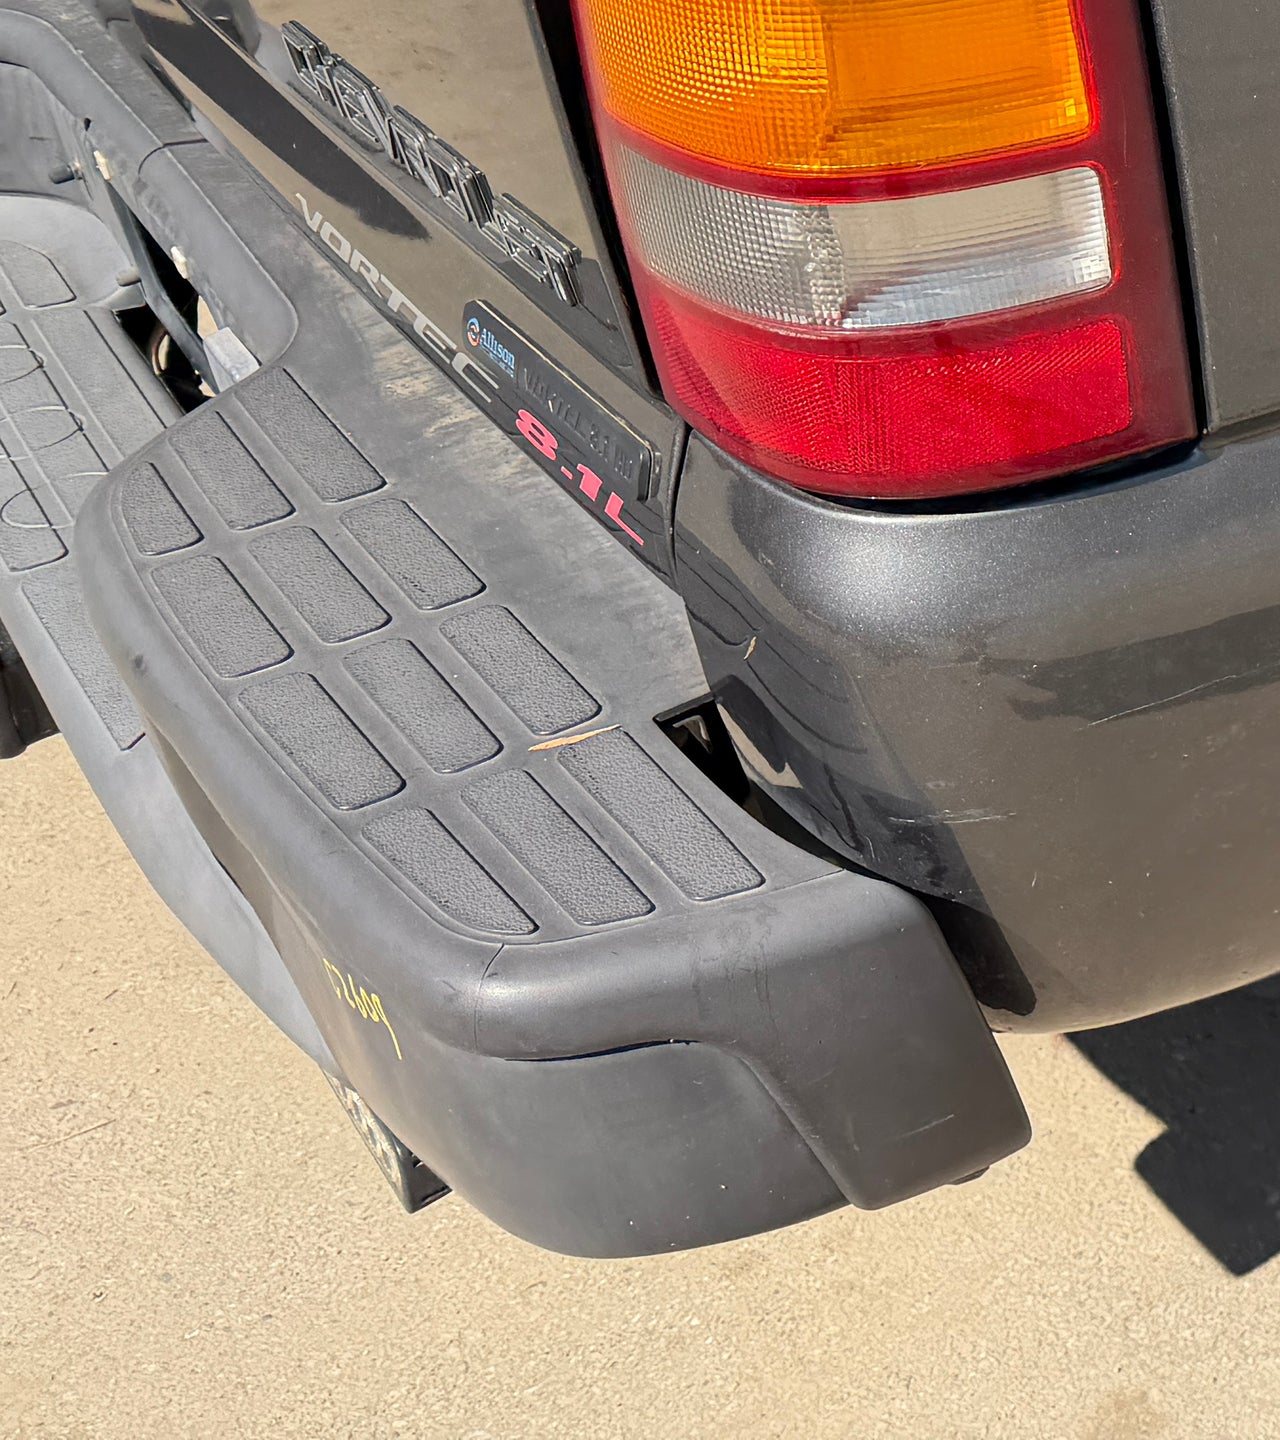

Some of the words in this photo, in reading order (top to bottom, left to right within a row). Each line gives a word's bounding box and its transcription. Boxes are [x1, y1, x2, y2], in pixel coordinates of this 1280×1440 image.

[281, 20, 582, 307] CHEVROLET
[295, 193, 499, 404] VORTEC
[480, 327, 516, 370] Allison
[514, 408, 645, 547] 8.1L
